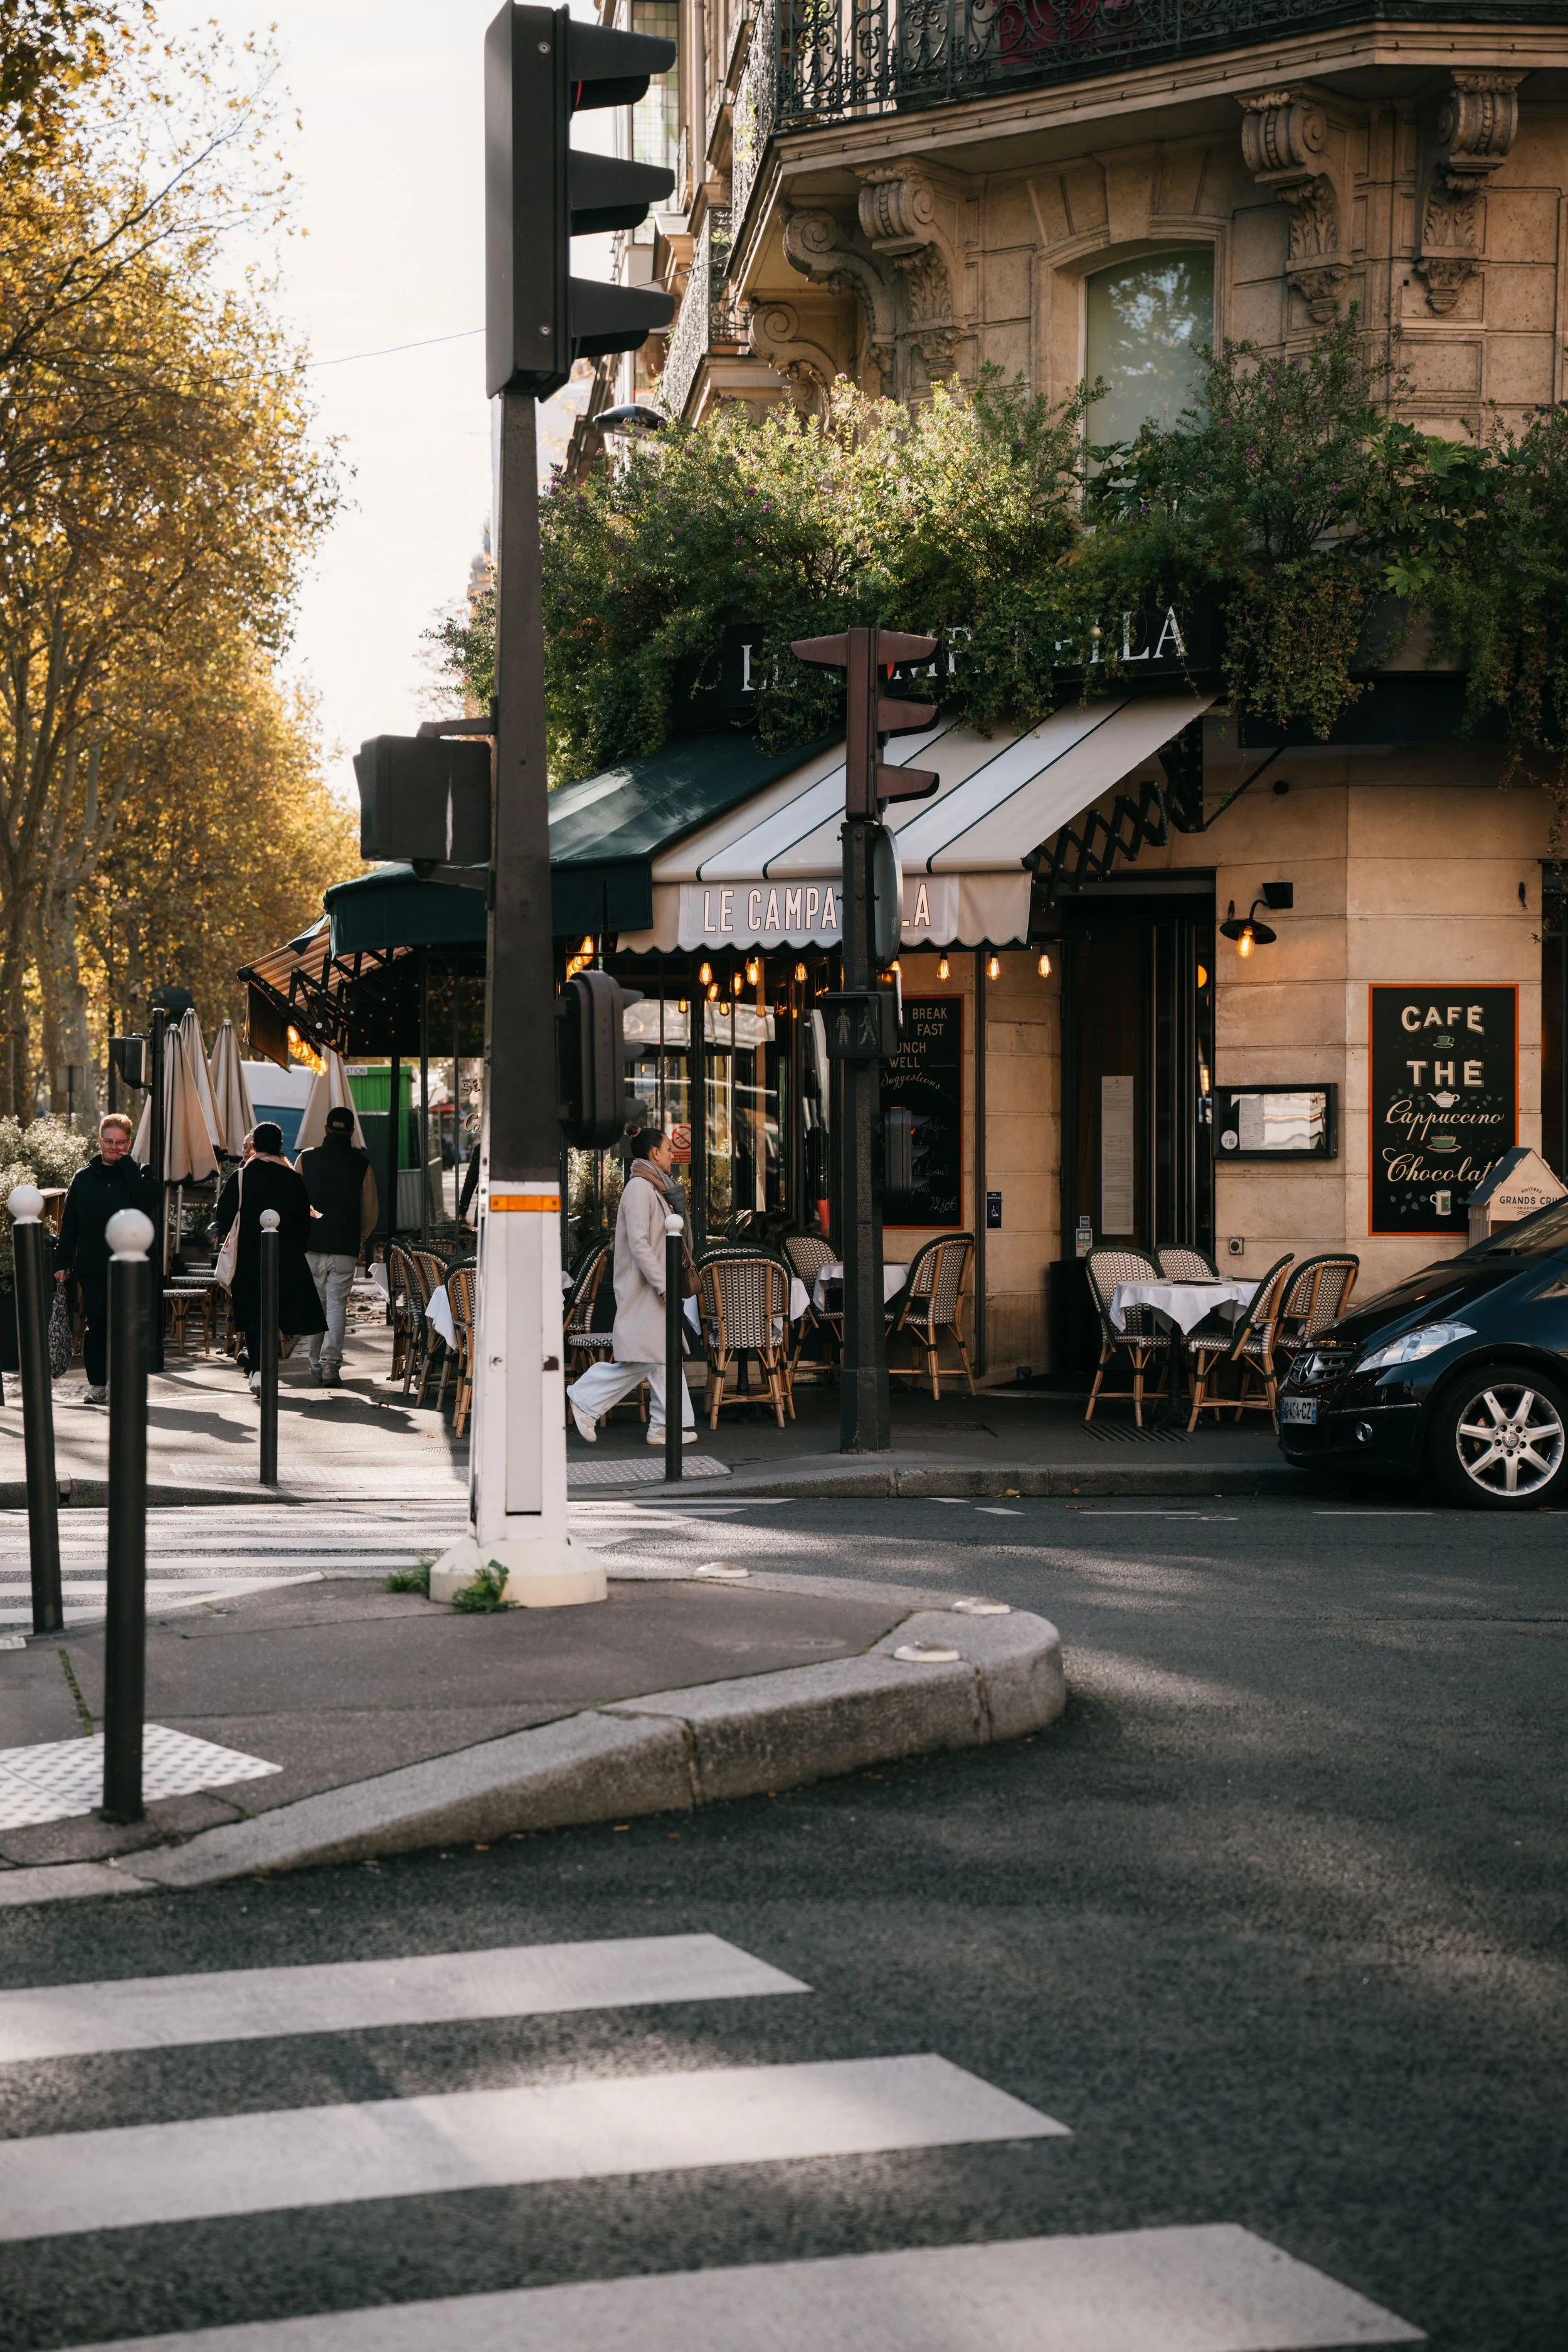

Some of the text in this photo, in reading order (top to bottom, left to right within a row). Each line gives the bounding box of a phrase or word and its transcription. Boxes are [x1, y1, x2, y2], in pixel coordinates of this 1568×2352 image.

[703, 890, 734, 932] LE
[912, 1007, 948, 1019] BREAK
[1401, 1005, 1485, 1036] CAFÉ
[917, 1024, 944, 1036] FAST
[897, 1042, 926, 1054] UNCH
[889, 1057, 920, 1067] WELL
[879, 1071, 941, 1089] Suggestions
[1406, 1059, 1484, 1087] THÉ
[1384, 1099, 1505, 1140] Cappuccino
[1382, 1148, 1495, 1182] Chocolat
[1500, 1196, 1562, 1205] GRANDS CRU
